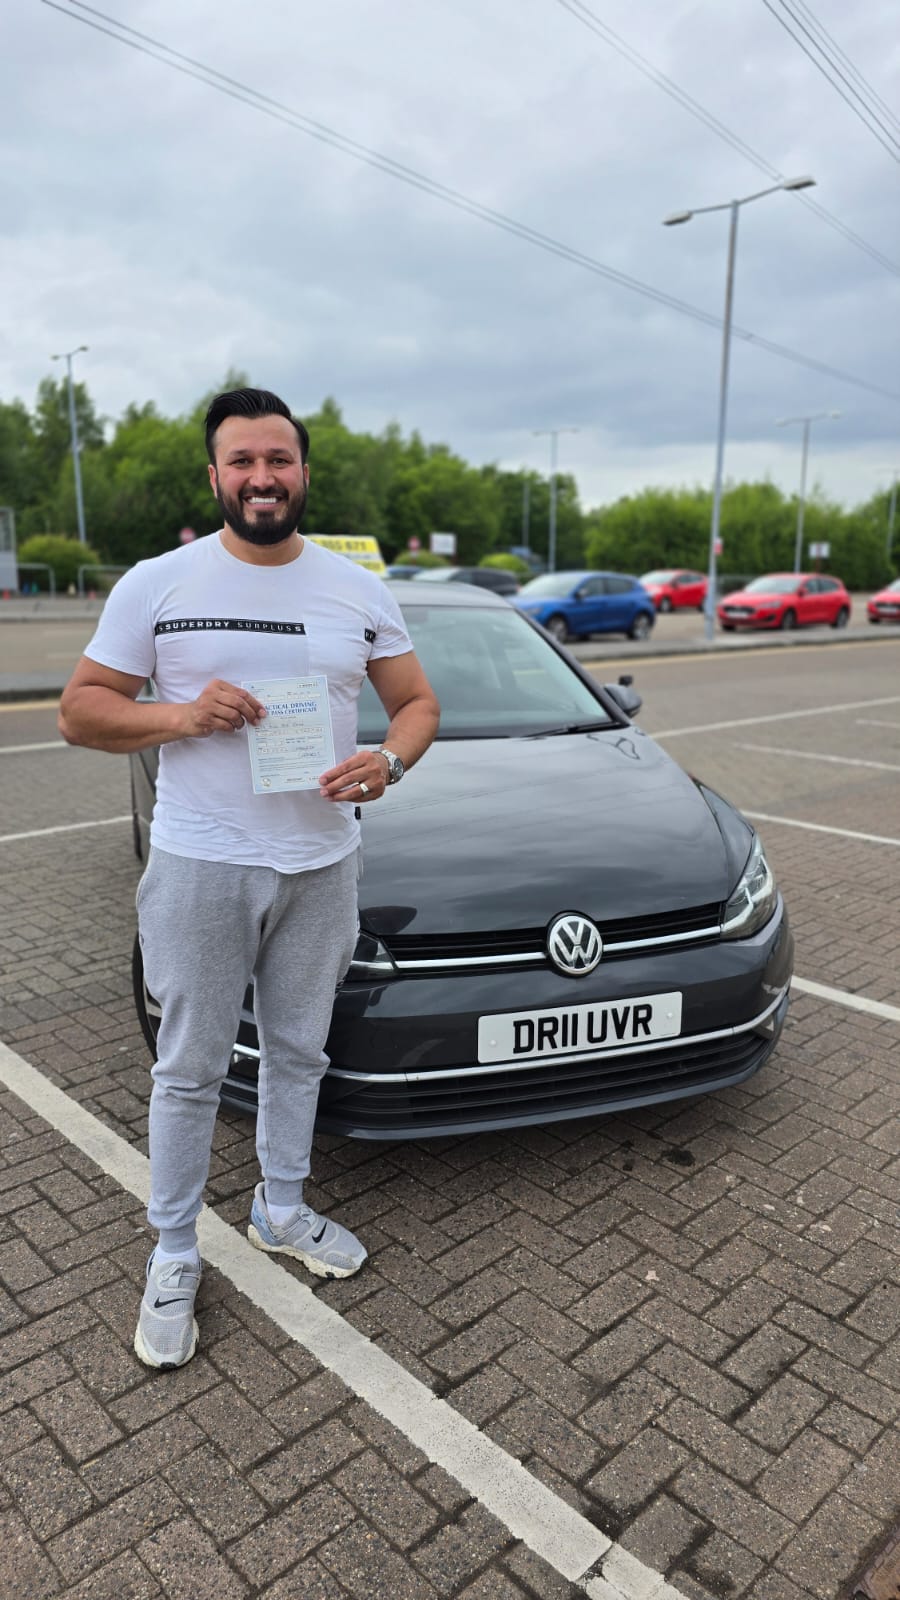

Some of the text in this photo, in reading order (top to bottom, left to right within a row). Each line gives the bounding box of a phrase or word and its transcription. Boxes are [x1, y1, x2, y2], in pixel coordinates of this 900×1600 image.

[165, 621, 230, 630] SUPERDRY
[290, 701, 317, 709] DRIVING
[284, 707, 317, 715] CERTIFICATE
[587, 1003, 653, 1044] UVR
